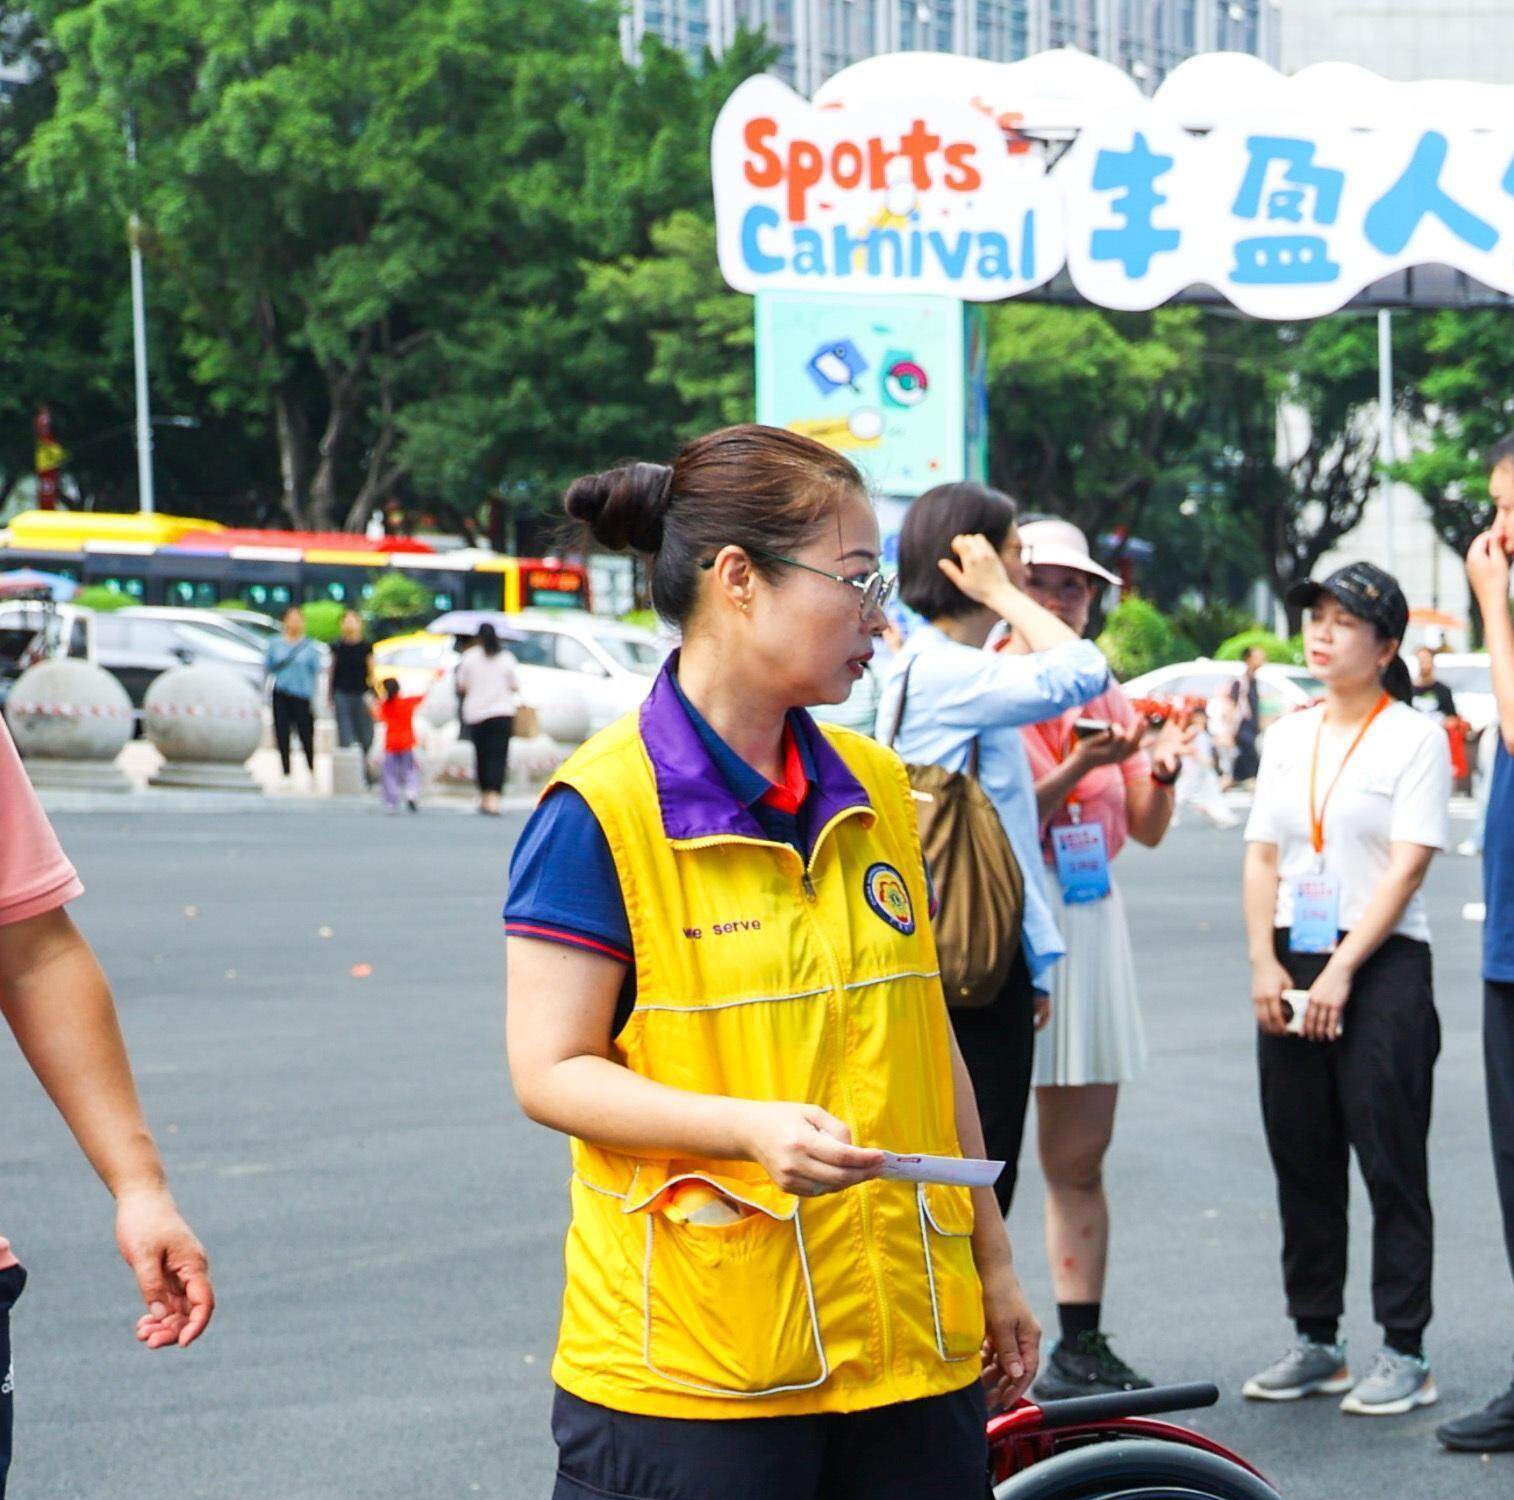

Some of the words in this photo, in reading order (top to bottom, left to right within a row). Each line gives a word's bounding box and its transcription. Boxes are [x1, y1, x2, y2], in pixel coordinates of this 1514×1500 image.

[743, 117, 981, 222] Sports
[740, 203, 1036, 281] Carnival
[712, 918, 761, 935] serve
